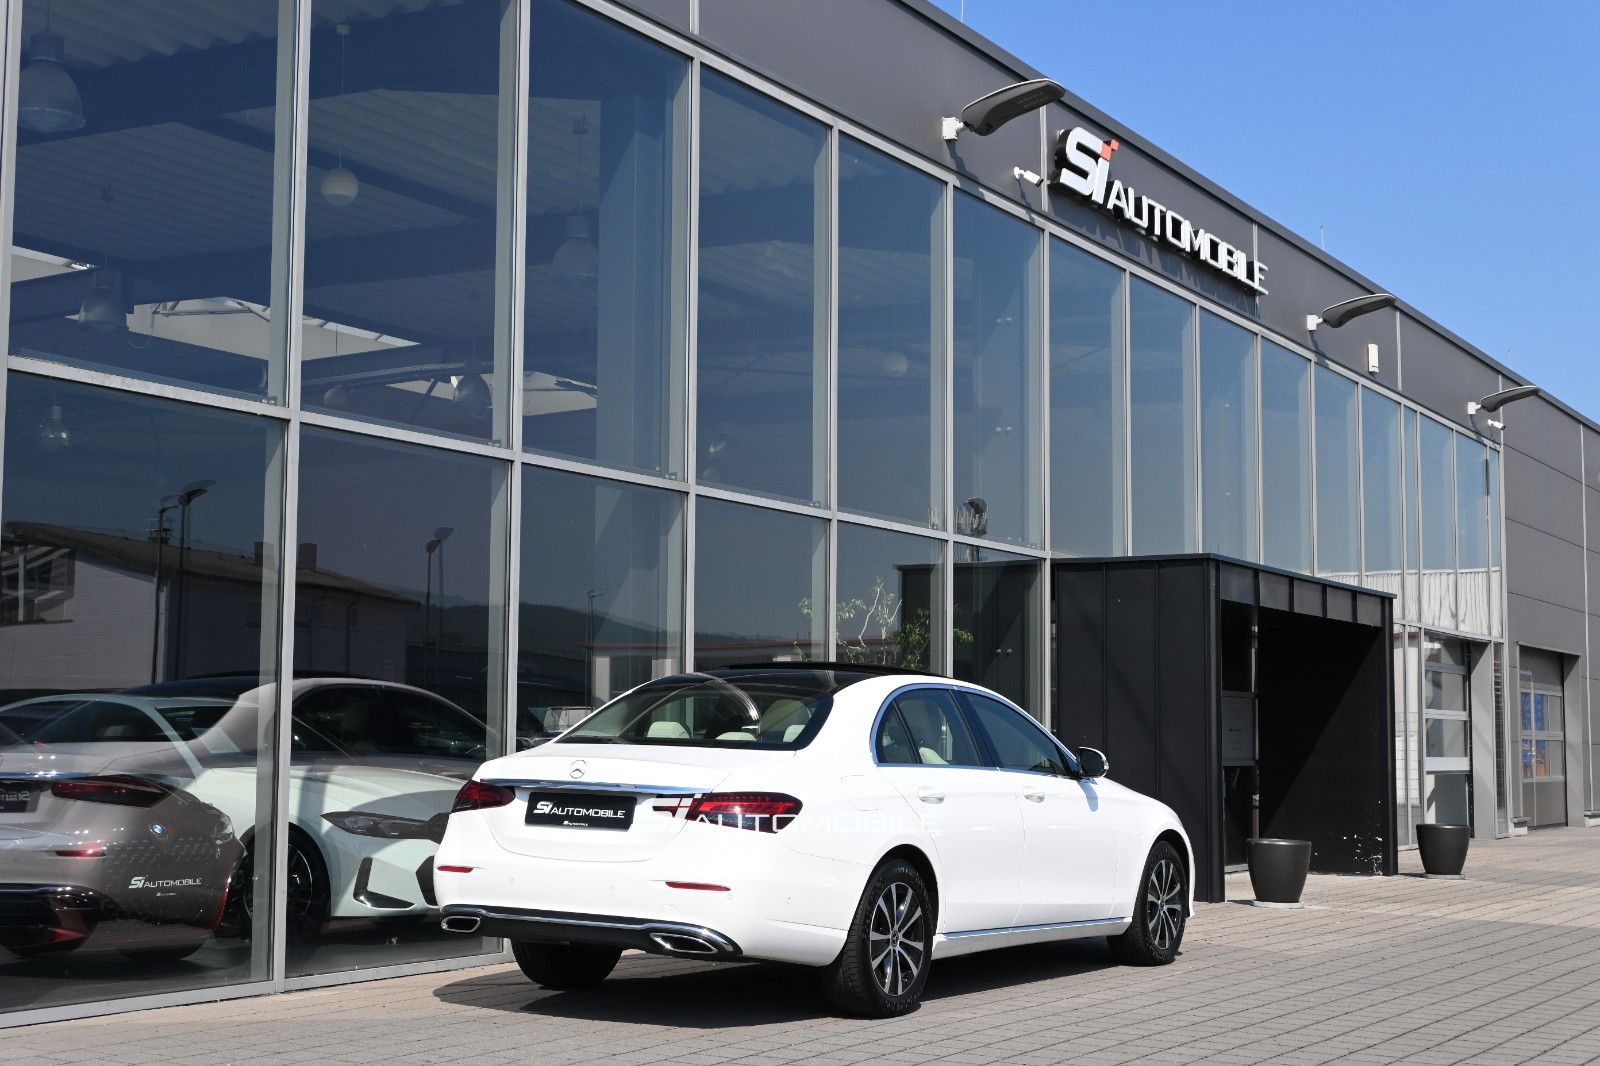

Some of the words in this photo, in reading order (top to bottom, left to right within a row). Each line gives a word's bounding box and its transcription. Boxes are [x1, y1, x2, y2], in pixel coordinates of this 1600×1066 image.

[1106, 179, 1269, 296] AUTOMOBILE
[550, 806, 626, 819] AUTOMOBILE
[143, 878, 202, 888] AUTOMOBILE
